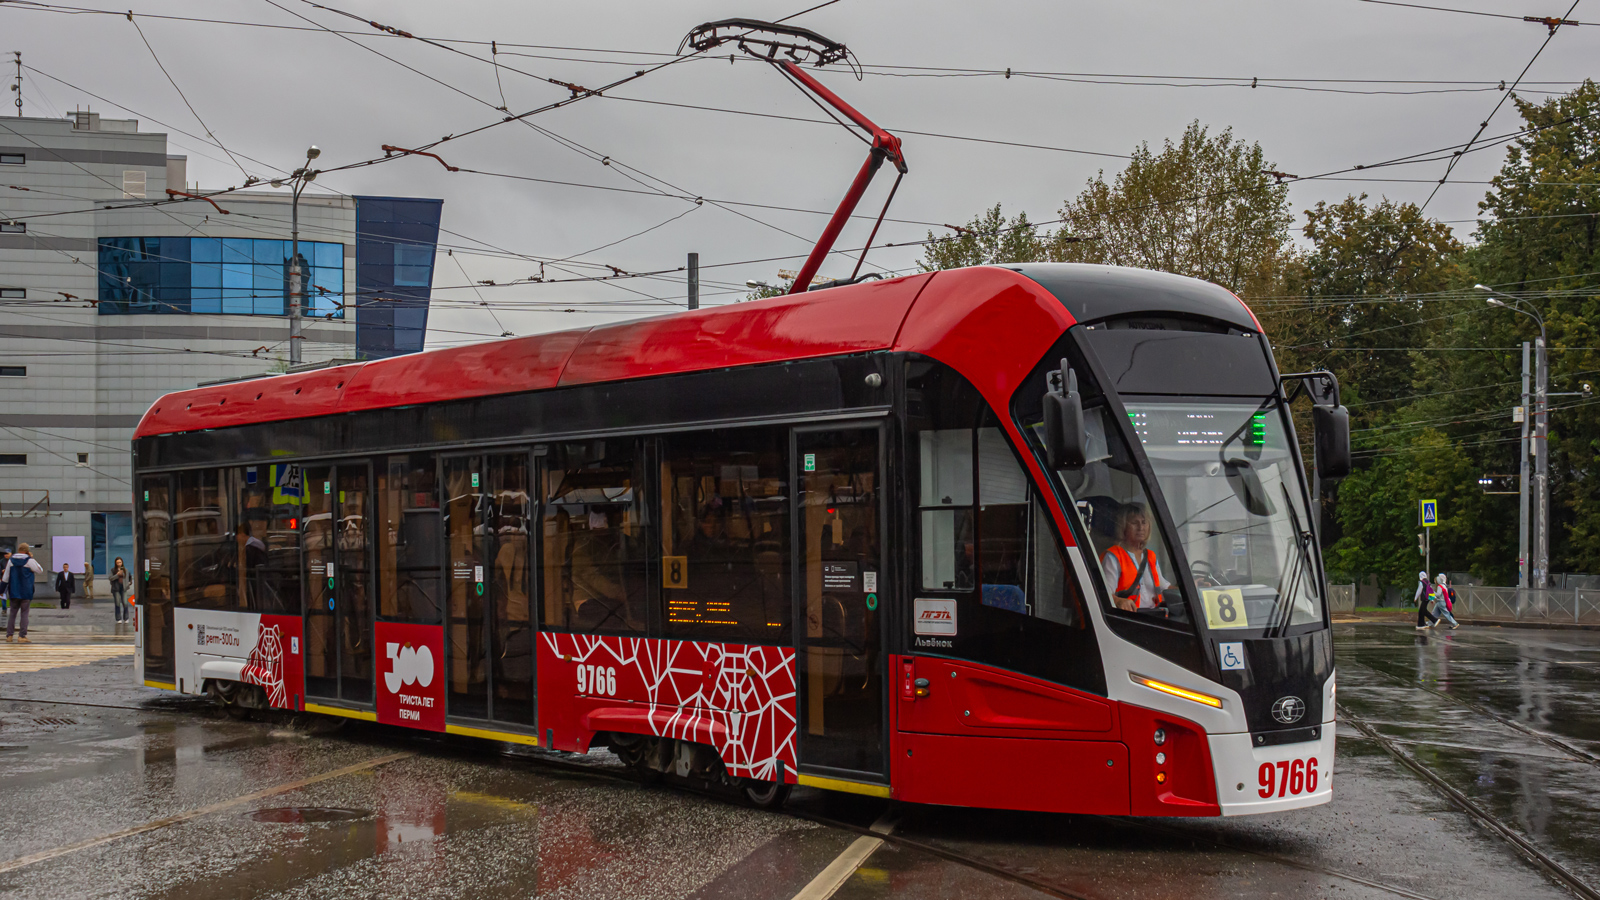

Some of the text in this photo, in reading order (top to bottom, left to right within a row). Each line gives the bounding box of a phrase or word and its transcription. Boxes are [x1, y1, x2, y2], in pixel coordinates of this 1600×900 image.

[670, 560, 682, 584] 8
[1217, 593, 1237, 623] 8
[206, 633, 240, 647] perm-300.ru
[915, 637, 952, 648] Львёнок
[384, 642, 434, 694] 300
[577, 664, 616, 696] 9766
[399, 694, 434, 708] ТРИСТА ЛЕТ
[399, 708, 420, 721] ПЕРМИ
[1258, 757, 1318, 799] 9766
